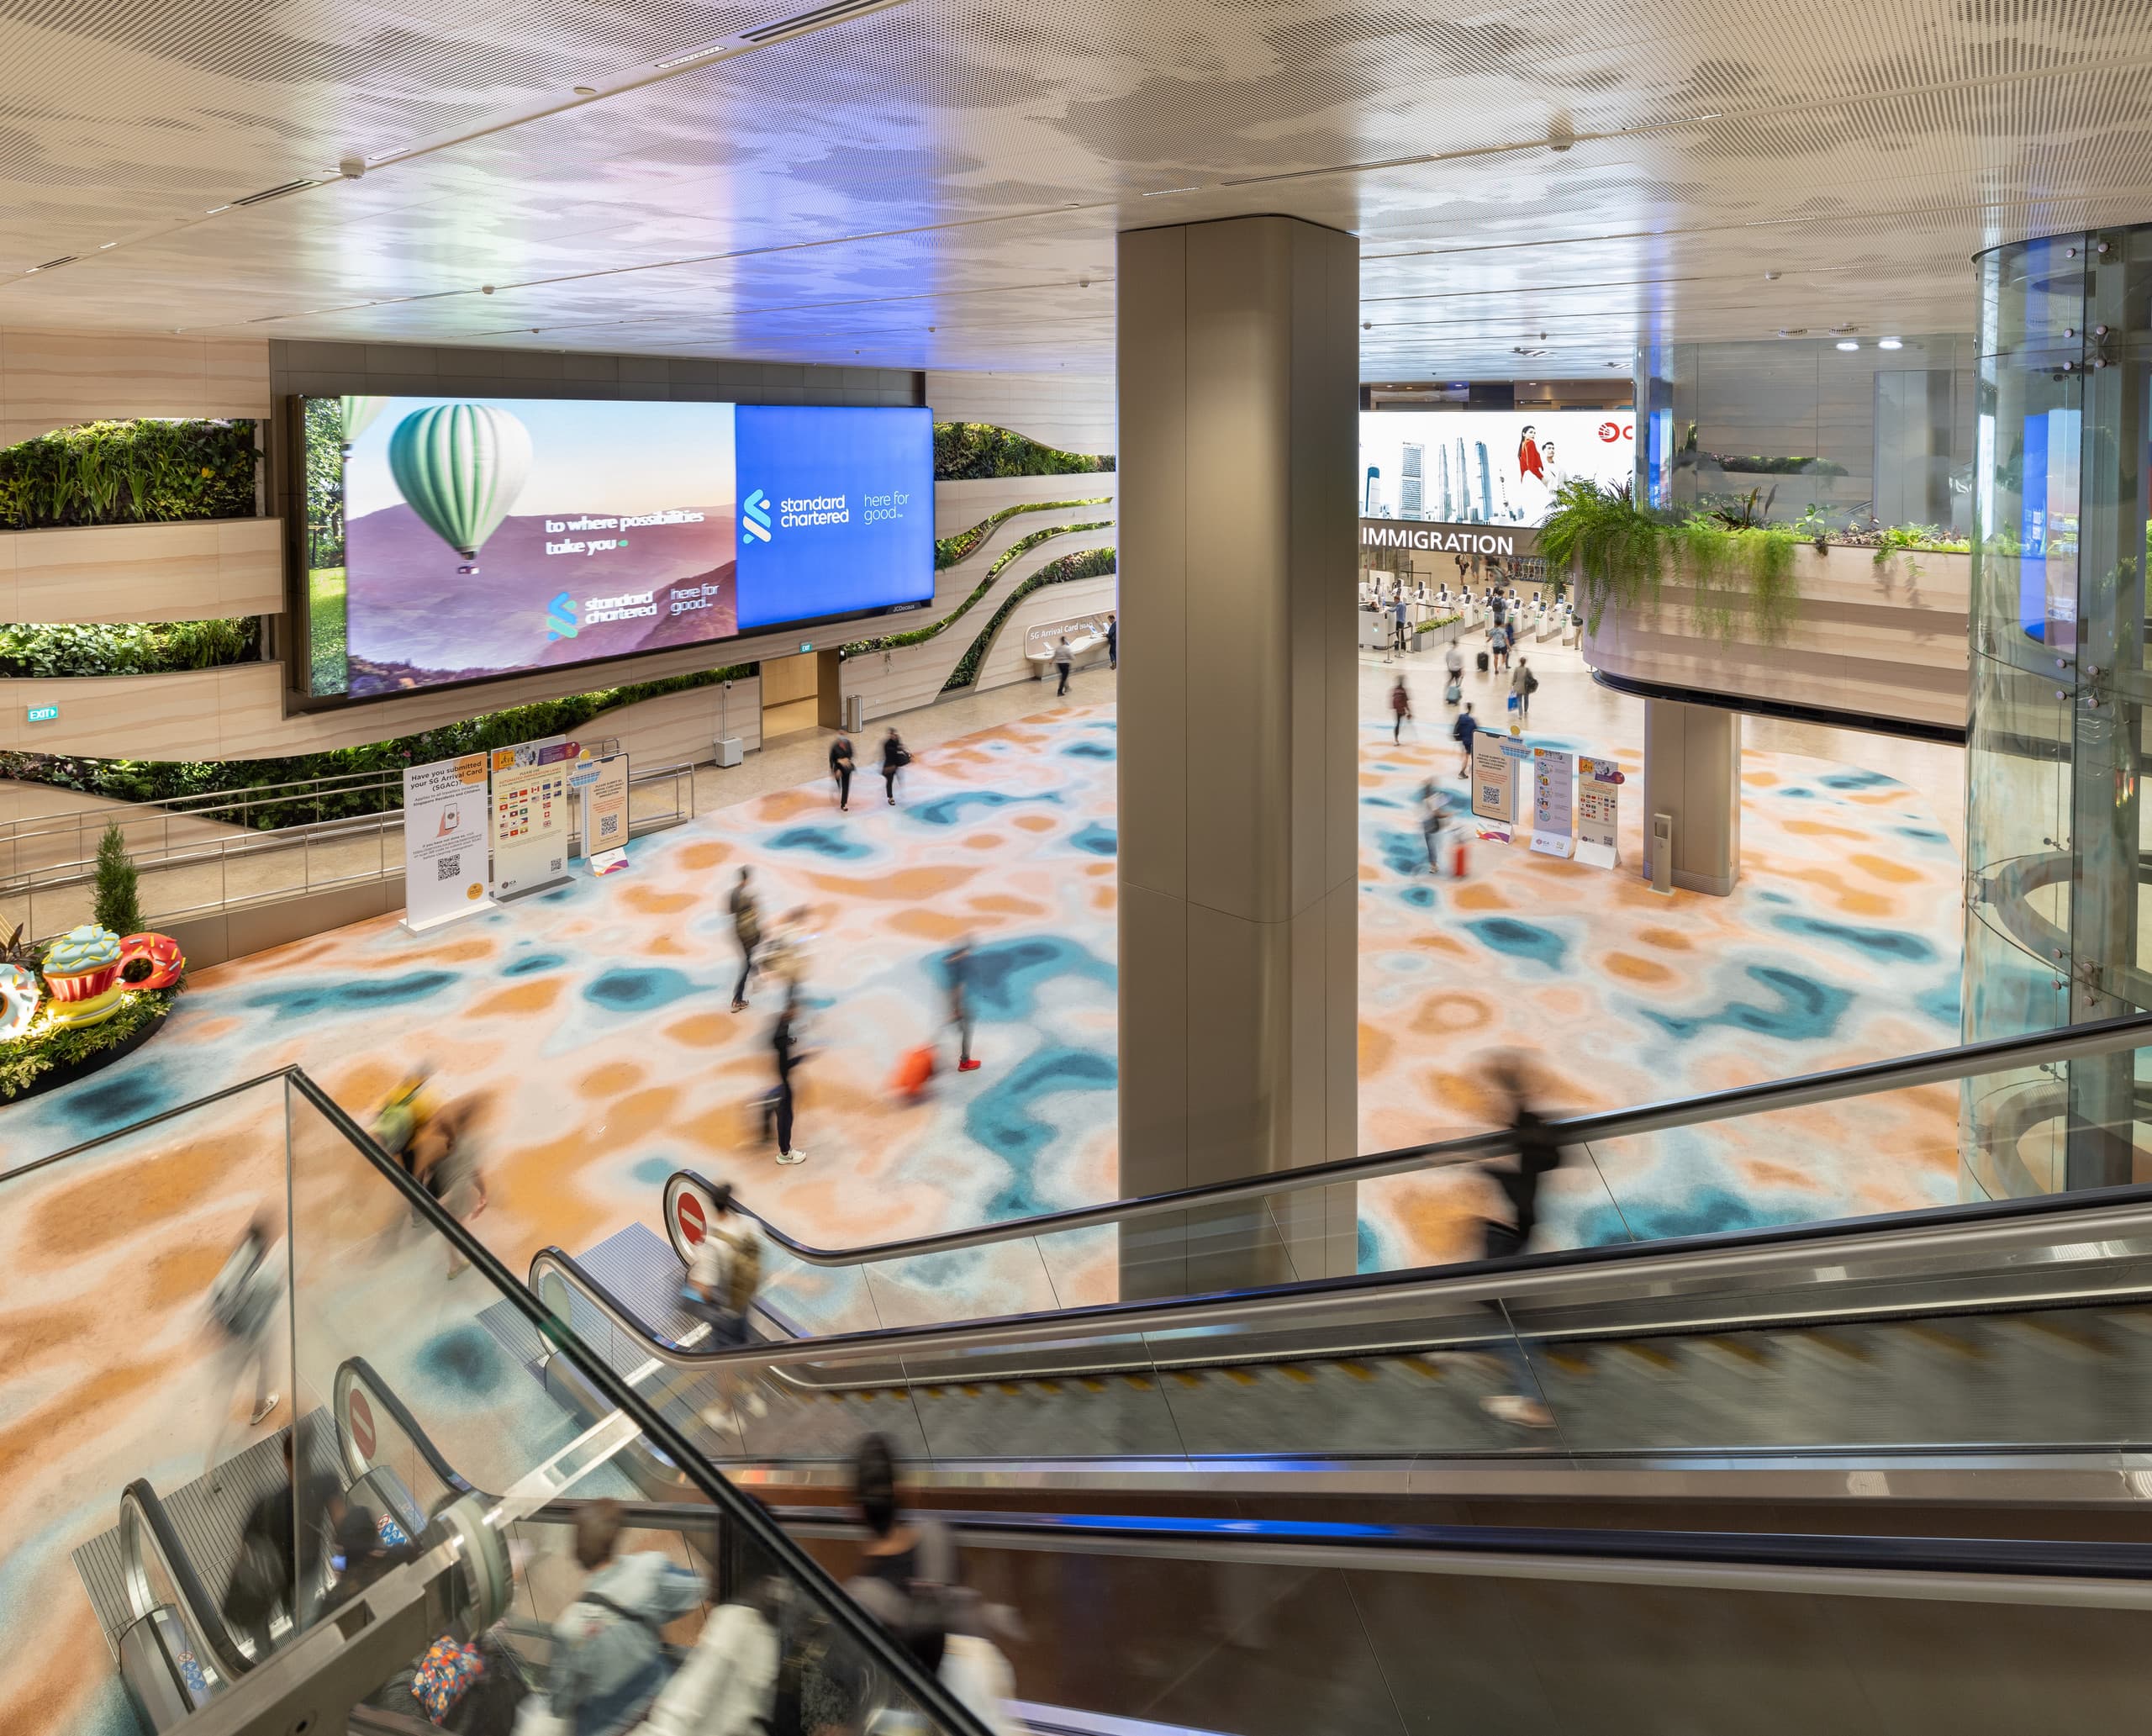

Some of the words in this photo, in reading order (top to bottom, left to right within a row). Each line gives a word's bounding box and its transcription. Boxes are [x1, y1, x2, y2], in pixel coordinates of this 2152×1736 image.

[780, 494, 846, 513] standard
[864, 493, 891, 507] here
[894, 491, 910, 504] for
[546, 520, 566, 532] to
[567, 516, 618, 530] where
[780, 509, 850, 527] chartered
[1363, 527, 1513, 555] IMMIGRATION
[585, 591, 653, 610] standard
[893, 604, 915, 613] JCDecaux
[585, 603, 657, 624] chartered
[1041, 626, 1063, 637] Arrival
[1064, 622, 1079, 633] Card
[30, 709, 50, 720] EXIT
[410, 781, 427, 790] your
[441, 772, 465, 781] Arrival
[466, 768, 483, 777] Card
[411, 773, 430, 782] Have
[446, 761, 482, 773] submitted
